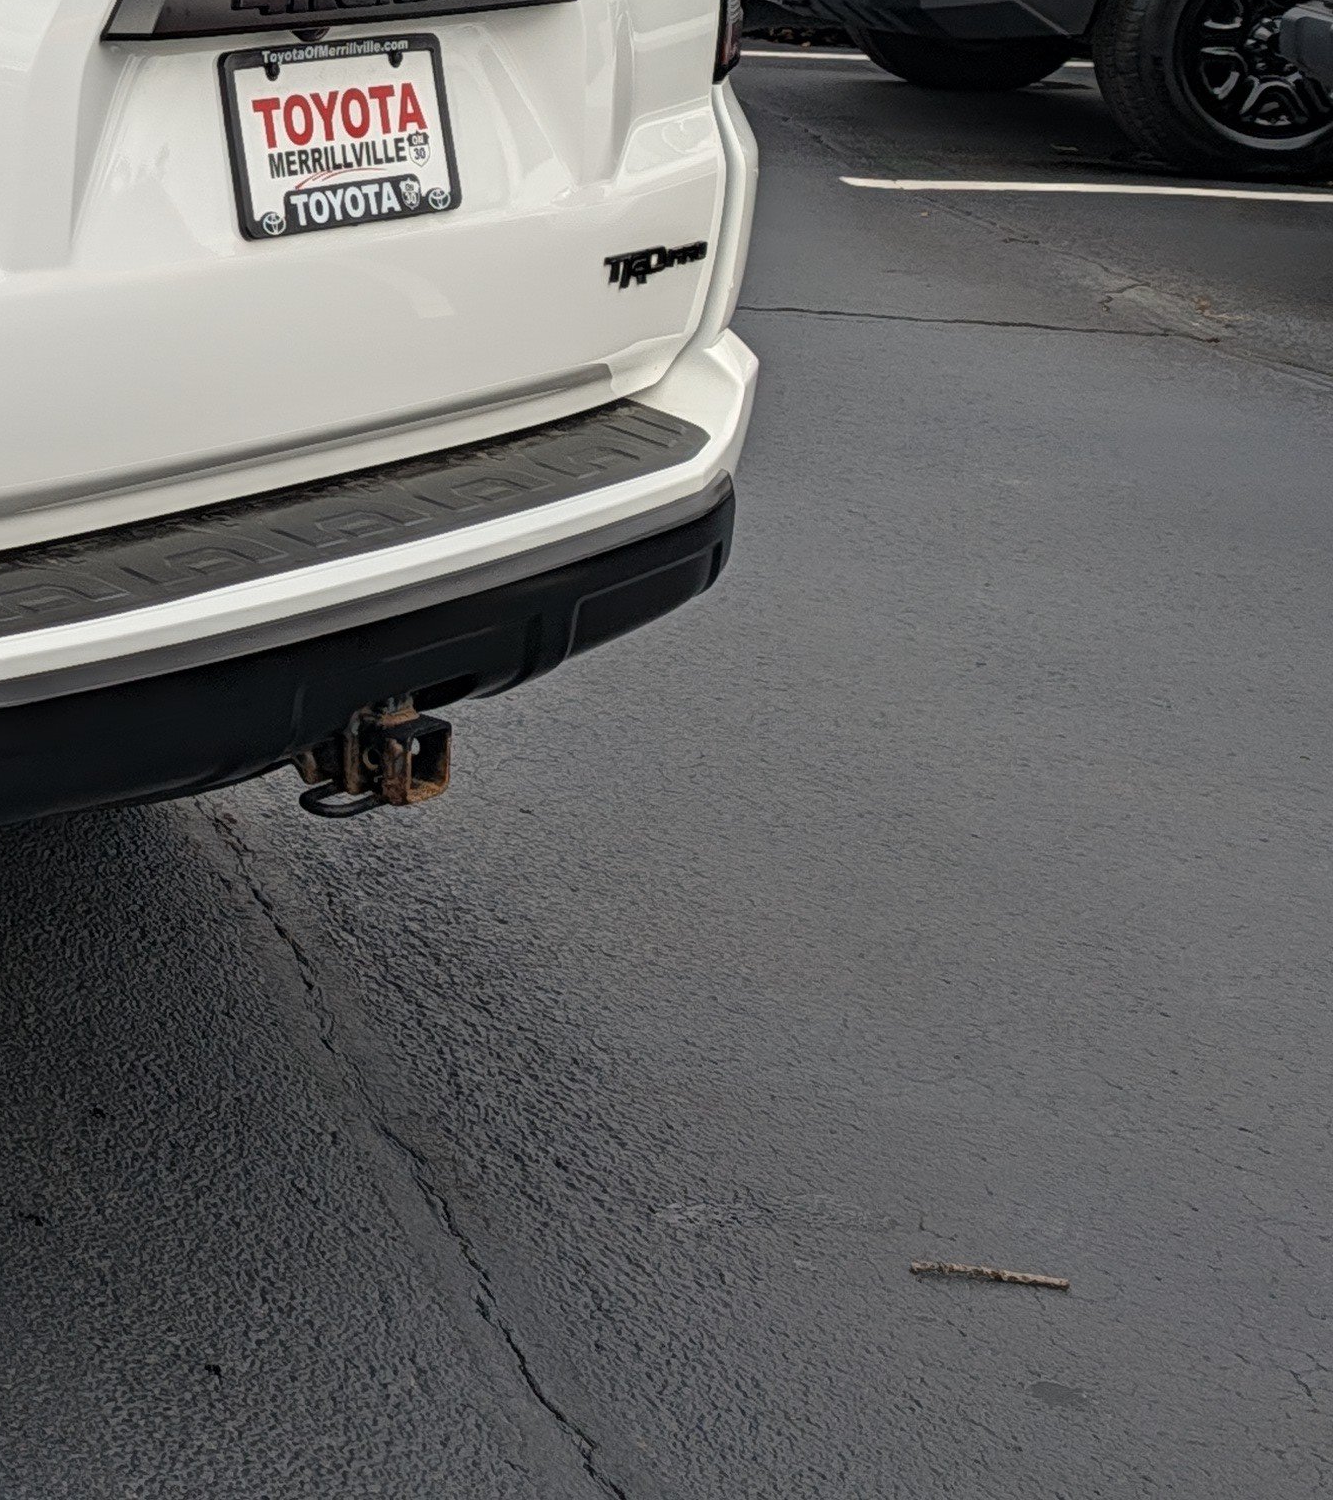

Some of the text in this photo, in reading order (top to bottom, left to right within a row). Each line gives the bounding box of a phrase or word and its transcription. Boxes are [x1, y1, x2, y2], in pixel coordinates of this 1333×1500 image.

[262, 39, 409, 65] ToyotaOfMerrillville.com
[251, 82, 428, 149] TOYOTA
[267, 137, 408, 179] MERRILLVILLE
[411, 133, 425, 145] ON
[413, 147, 427, 161] 30
[290, 182, 402, 226] TOYOTA
[603, 246, 667, 290] TRD
